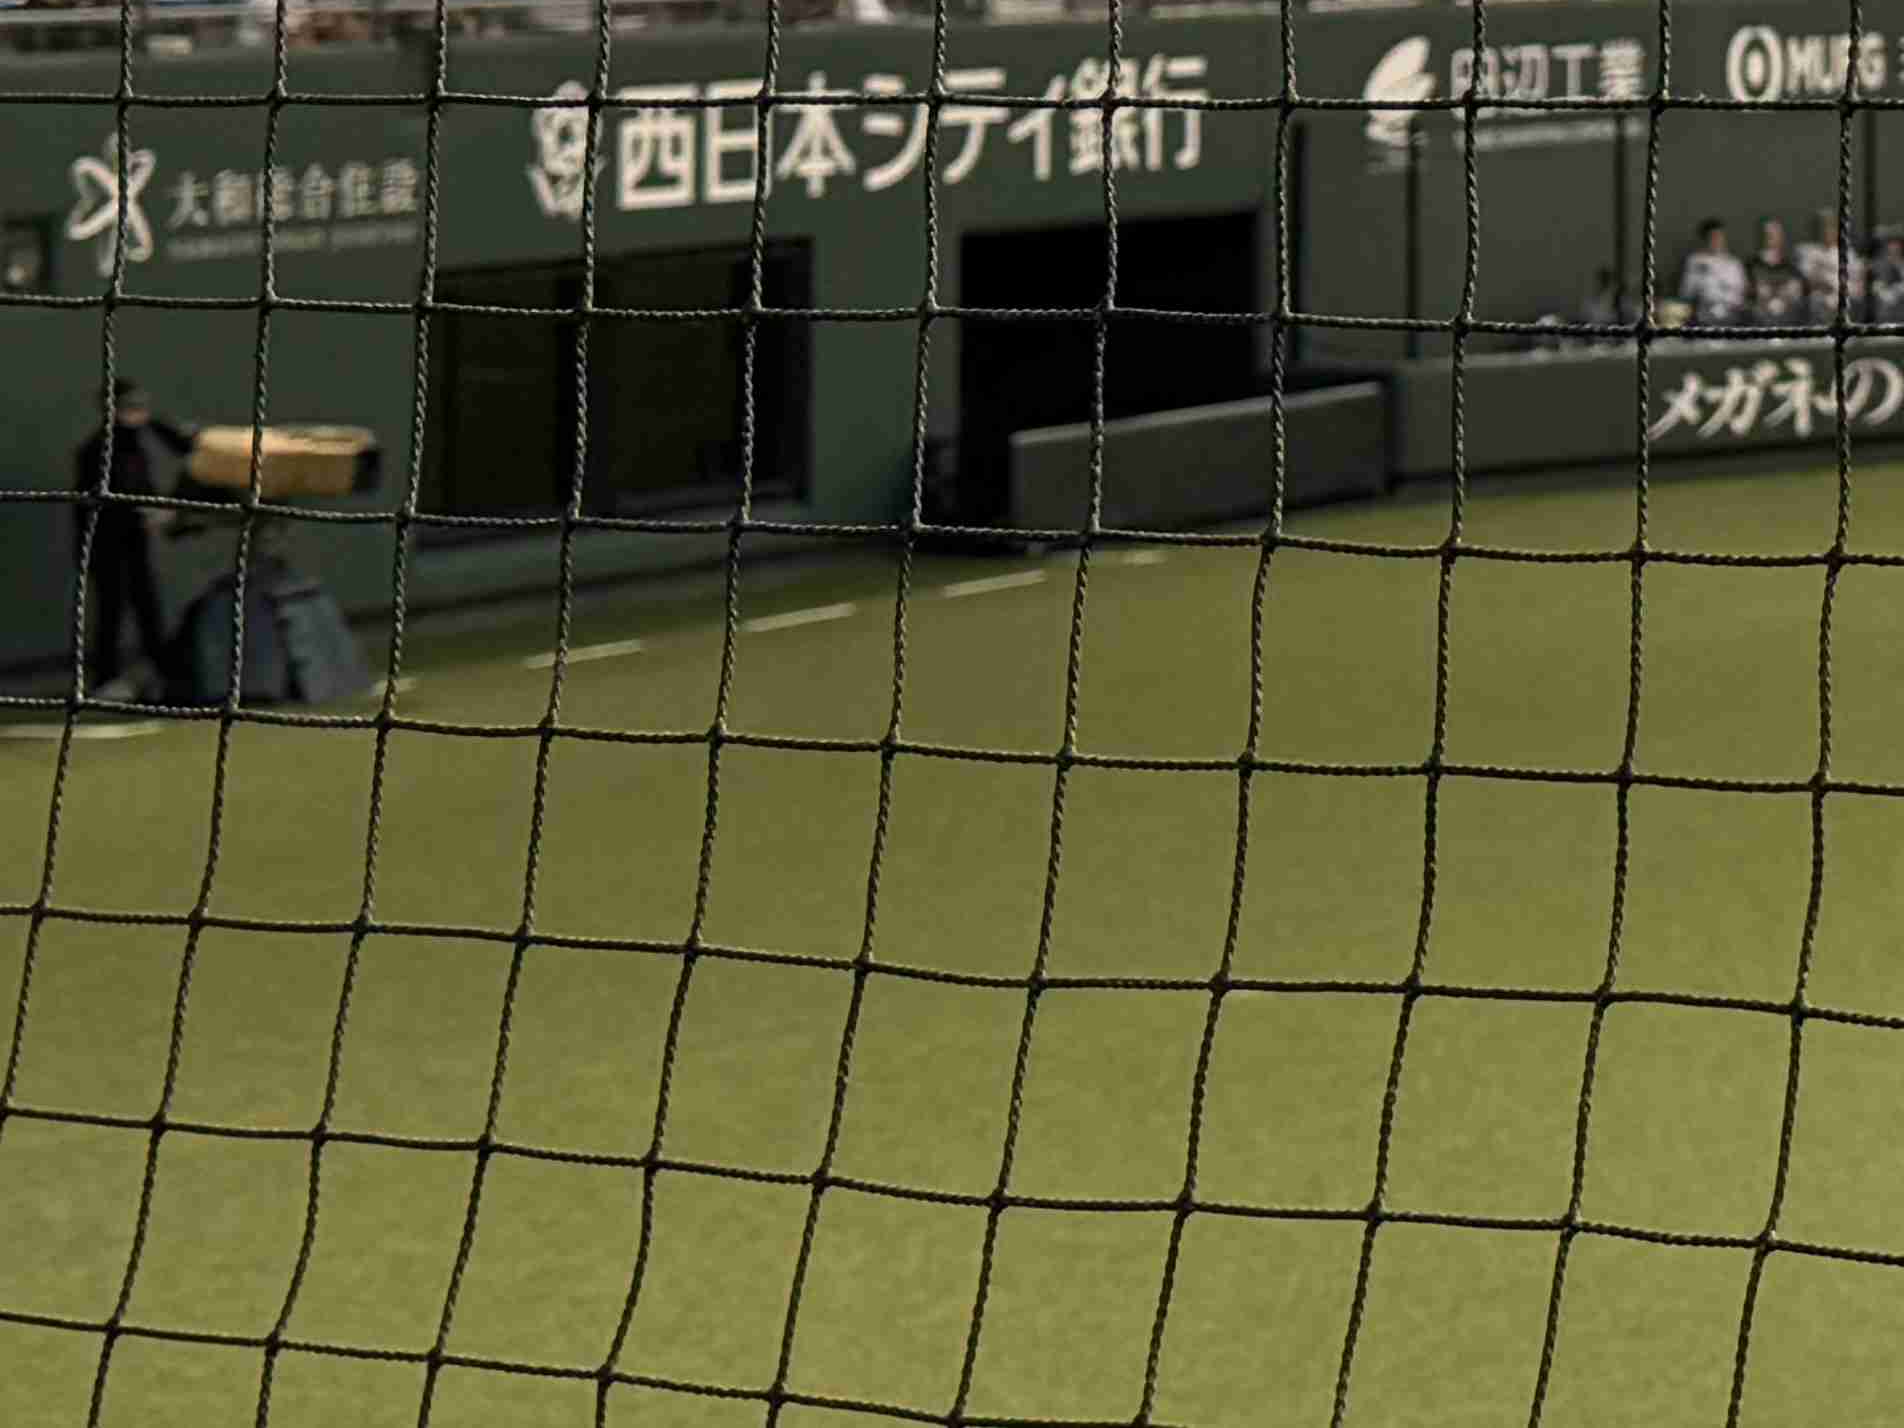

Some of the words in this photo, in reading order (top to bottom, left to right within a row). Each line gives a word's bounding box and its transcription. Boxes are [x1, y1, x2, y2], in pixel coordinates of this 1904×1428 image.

[617, 52, 1210, 212] 西日本シティ銀行
